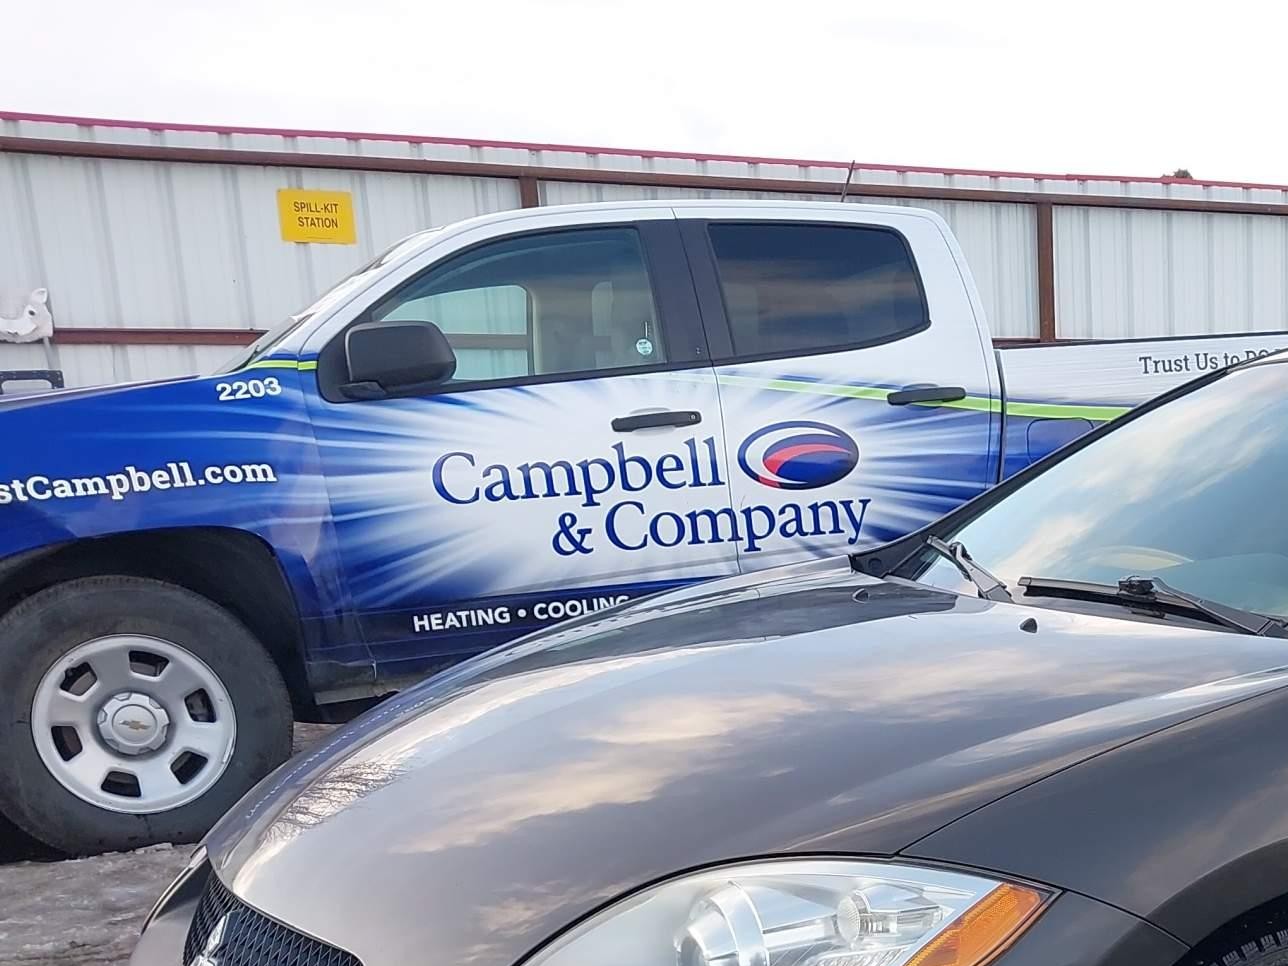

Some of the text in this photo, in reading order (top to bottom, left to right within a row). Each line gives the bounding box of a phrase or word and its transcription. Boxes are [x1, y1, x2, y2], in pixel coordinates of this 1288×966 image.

[293, 201, 339, 213] SPILL-KIT
[297, 216, 338, 228] STATION
[1139, 355, 1190, 374] Trust
[1195, 353, 1218, 370] Us
[216, 377, 282, 401] 2203
[0, 462, 277, 504] stCampbell.com
[432, 436, 725, 507] Campbell
[552, 497, 872, 557] & Company
[413, 607, 511, 633] HEATING
